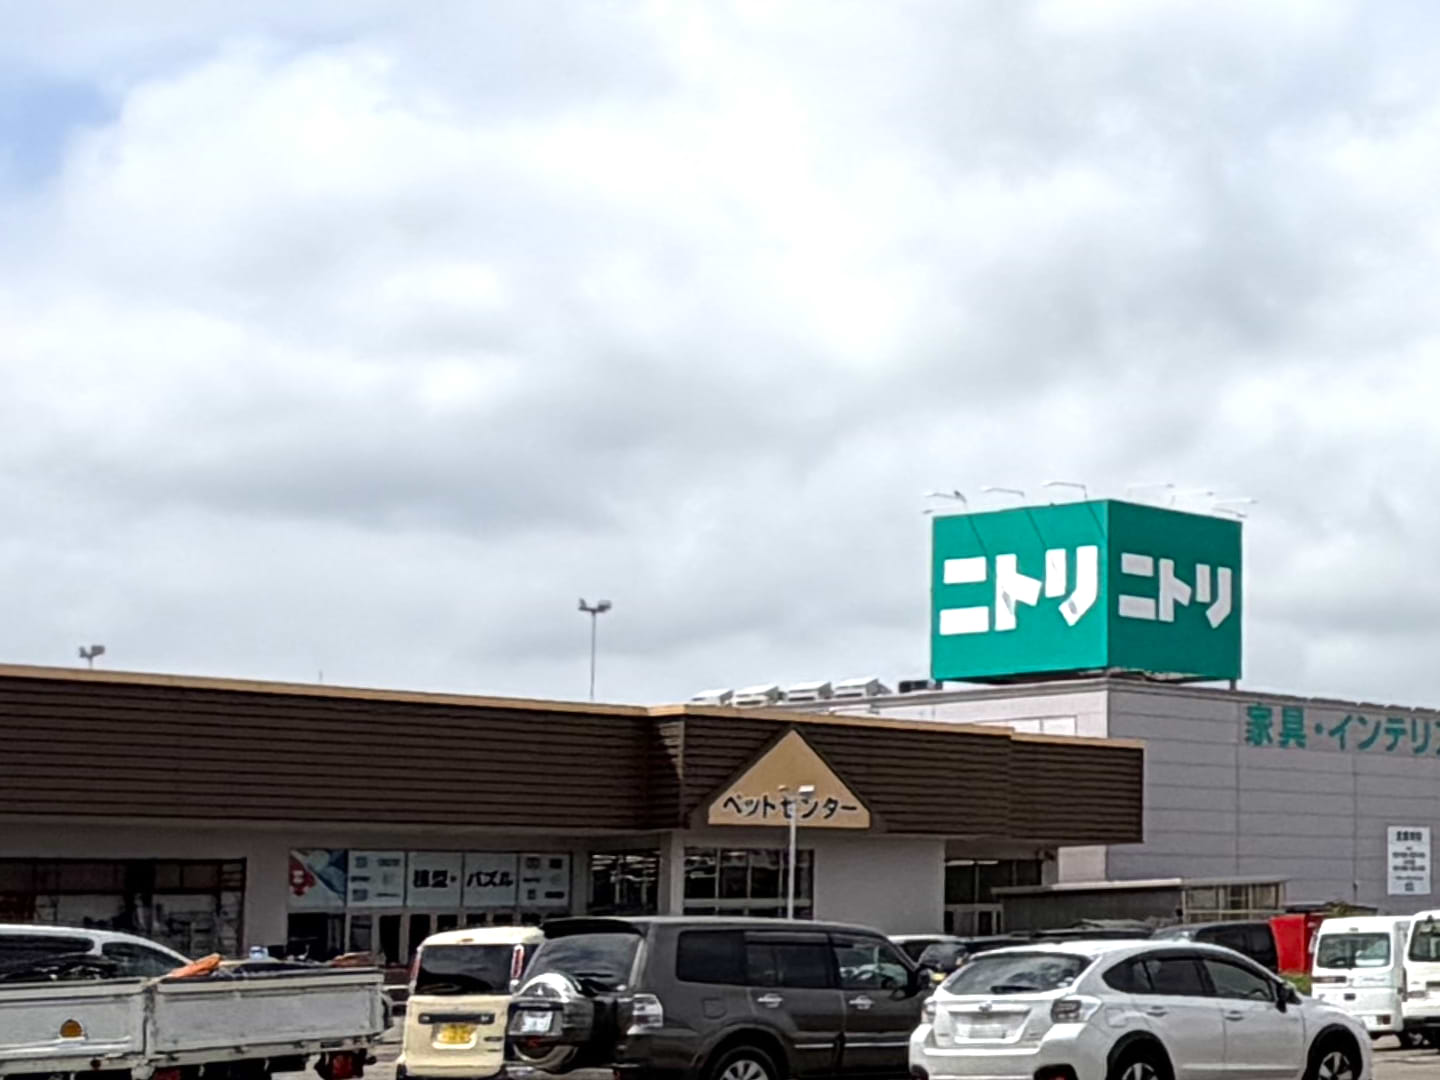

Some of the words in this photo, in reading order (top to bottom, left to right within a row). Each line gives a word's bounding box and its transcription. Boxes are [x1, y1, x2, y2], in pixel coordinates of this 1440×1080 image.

[939, 545, 1098, 635] ニトリ
[1118, 552, 1232, 629] ニトリ
[723, 794, 858, 819] ペットセンター
